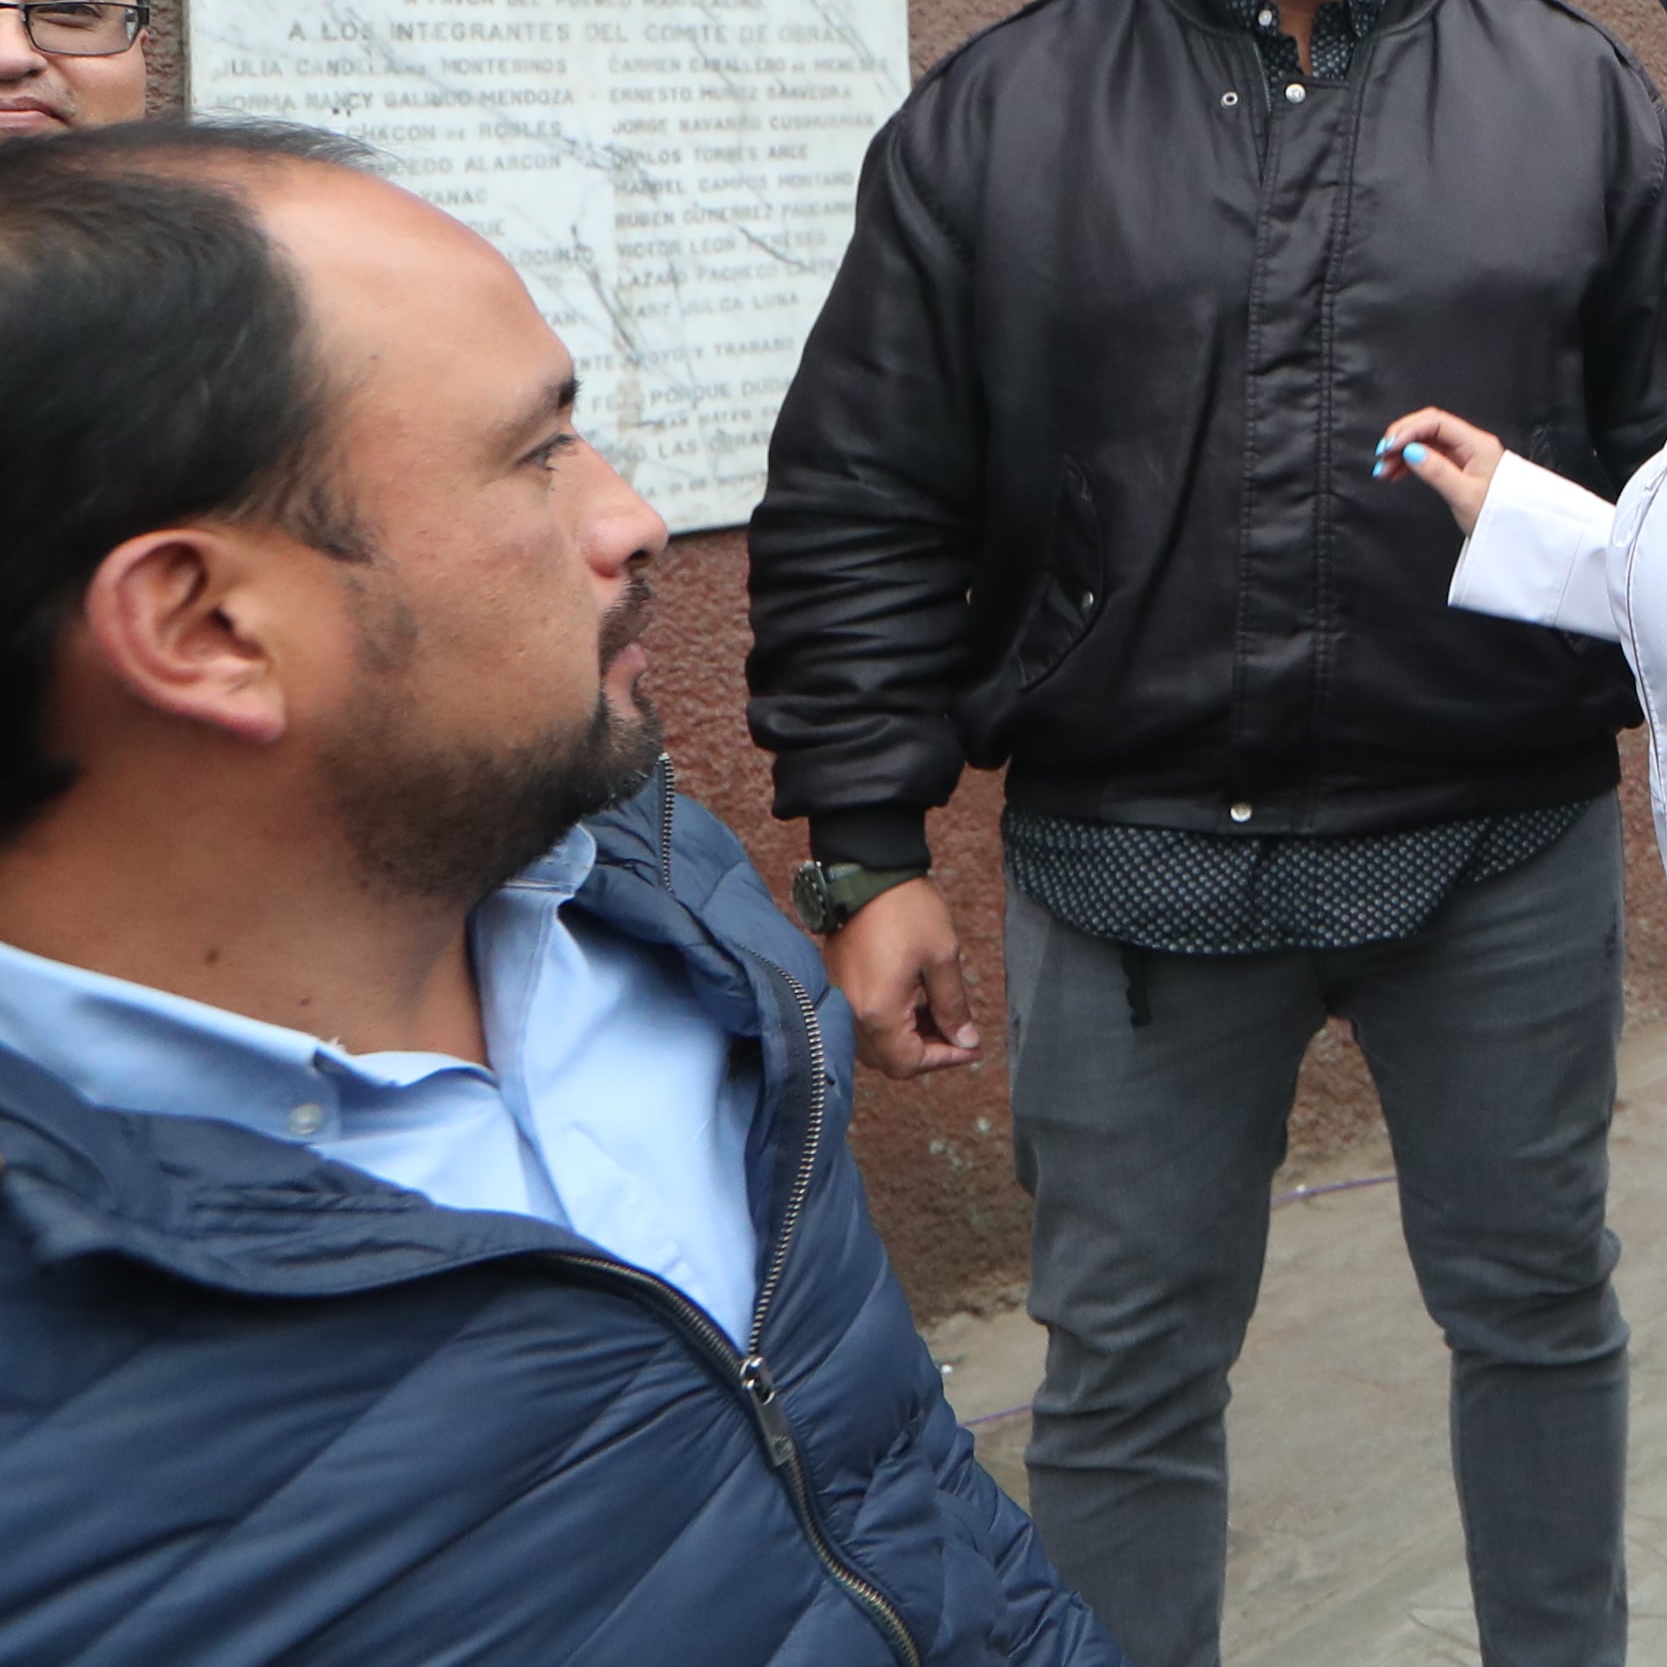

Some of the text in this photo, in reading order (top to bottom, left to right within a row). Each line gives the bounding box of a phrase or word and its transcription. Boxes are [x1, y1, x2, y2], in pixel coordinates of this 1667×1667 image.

[288, 21, 307, 41] A
[389, 21, 572, 44] INTEGRANTES
[584, 22, 629, 44] DEL
[478, 86, 575, 108] MENDOZA
[463, 153, 562, 173] ALARCON
